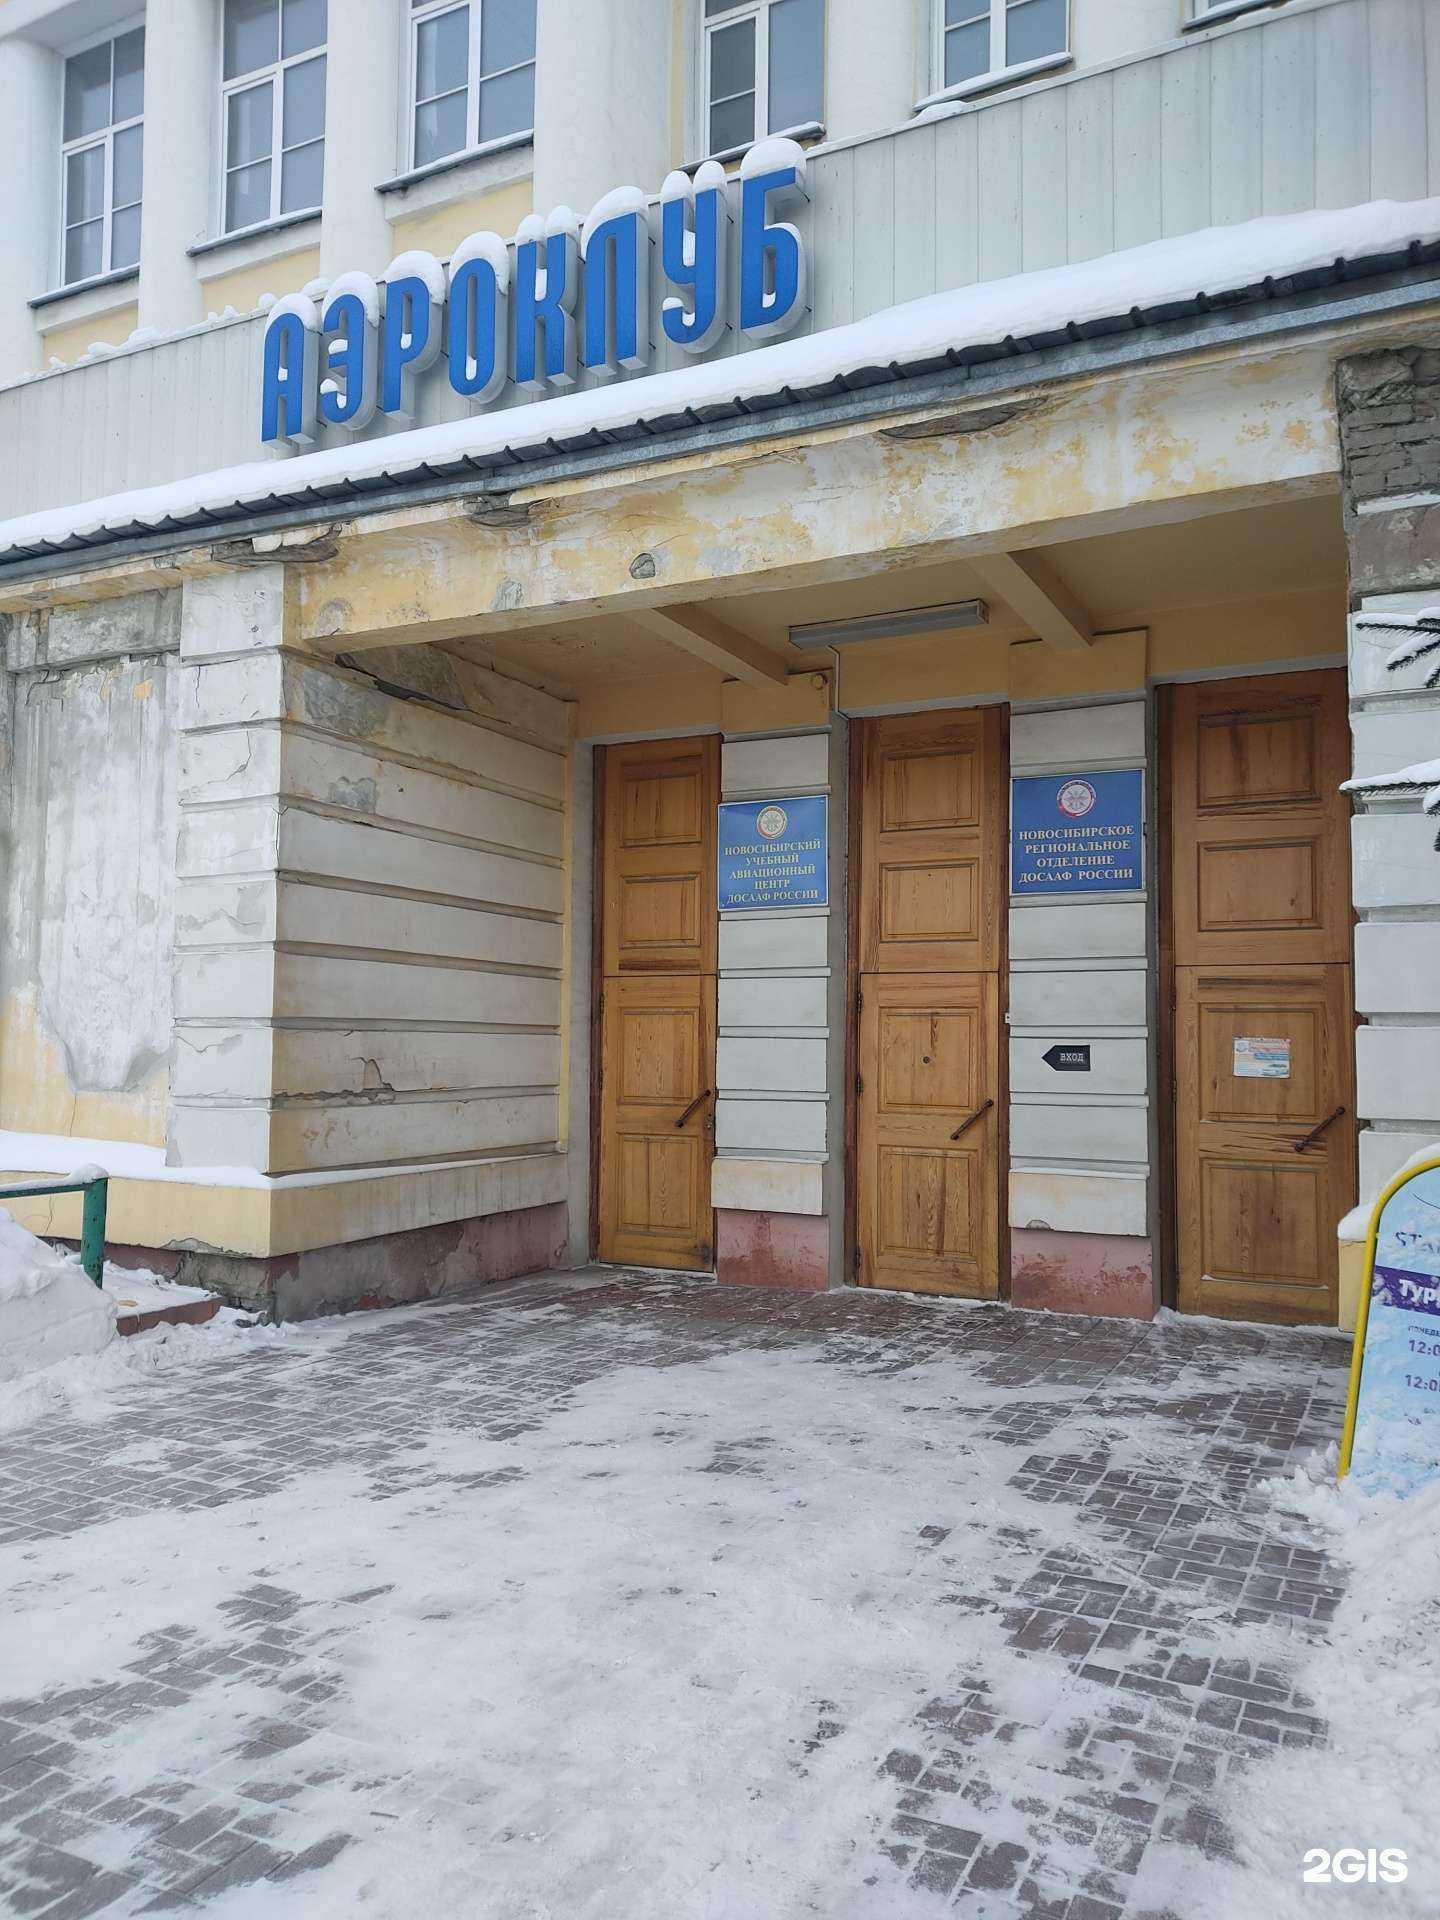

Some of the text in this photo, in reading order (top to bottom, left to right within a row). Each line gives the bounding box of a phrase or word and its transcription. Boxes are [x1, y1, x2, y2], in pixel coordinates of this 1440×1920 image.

[262, 166, 803, 446] АЭРОКЛУБ
[1019, 825, 1134, 840] НОВОСИБИРСКОЕ
[725, 839, 820, 855] НОВОСИБИРСКИЙ
[1025, 840, 1131, 854] РЕГИОНАЛЬНОЕ
[746, 853, 799, 866] УЧЕБНЫЙ
[1037, 855, 1115, 868] ОТДЕЛЕНИЕ
[731, 864, 816, 879] АВИАЦИОННЫЙ
[1019, 869, 1133, 883] ДОСААФ РОССИИ
[755, 879, 790, 890] ЦЕНТР
[728, 889, 818, 904] ДОСААФ РОССИИ
[1060, 1053, 1084, 1062] ВХОД
[1399, 1279, 1440, 1308] ТУР
[1405, 1374, 1440, 1392] 12:0
